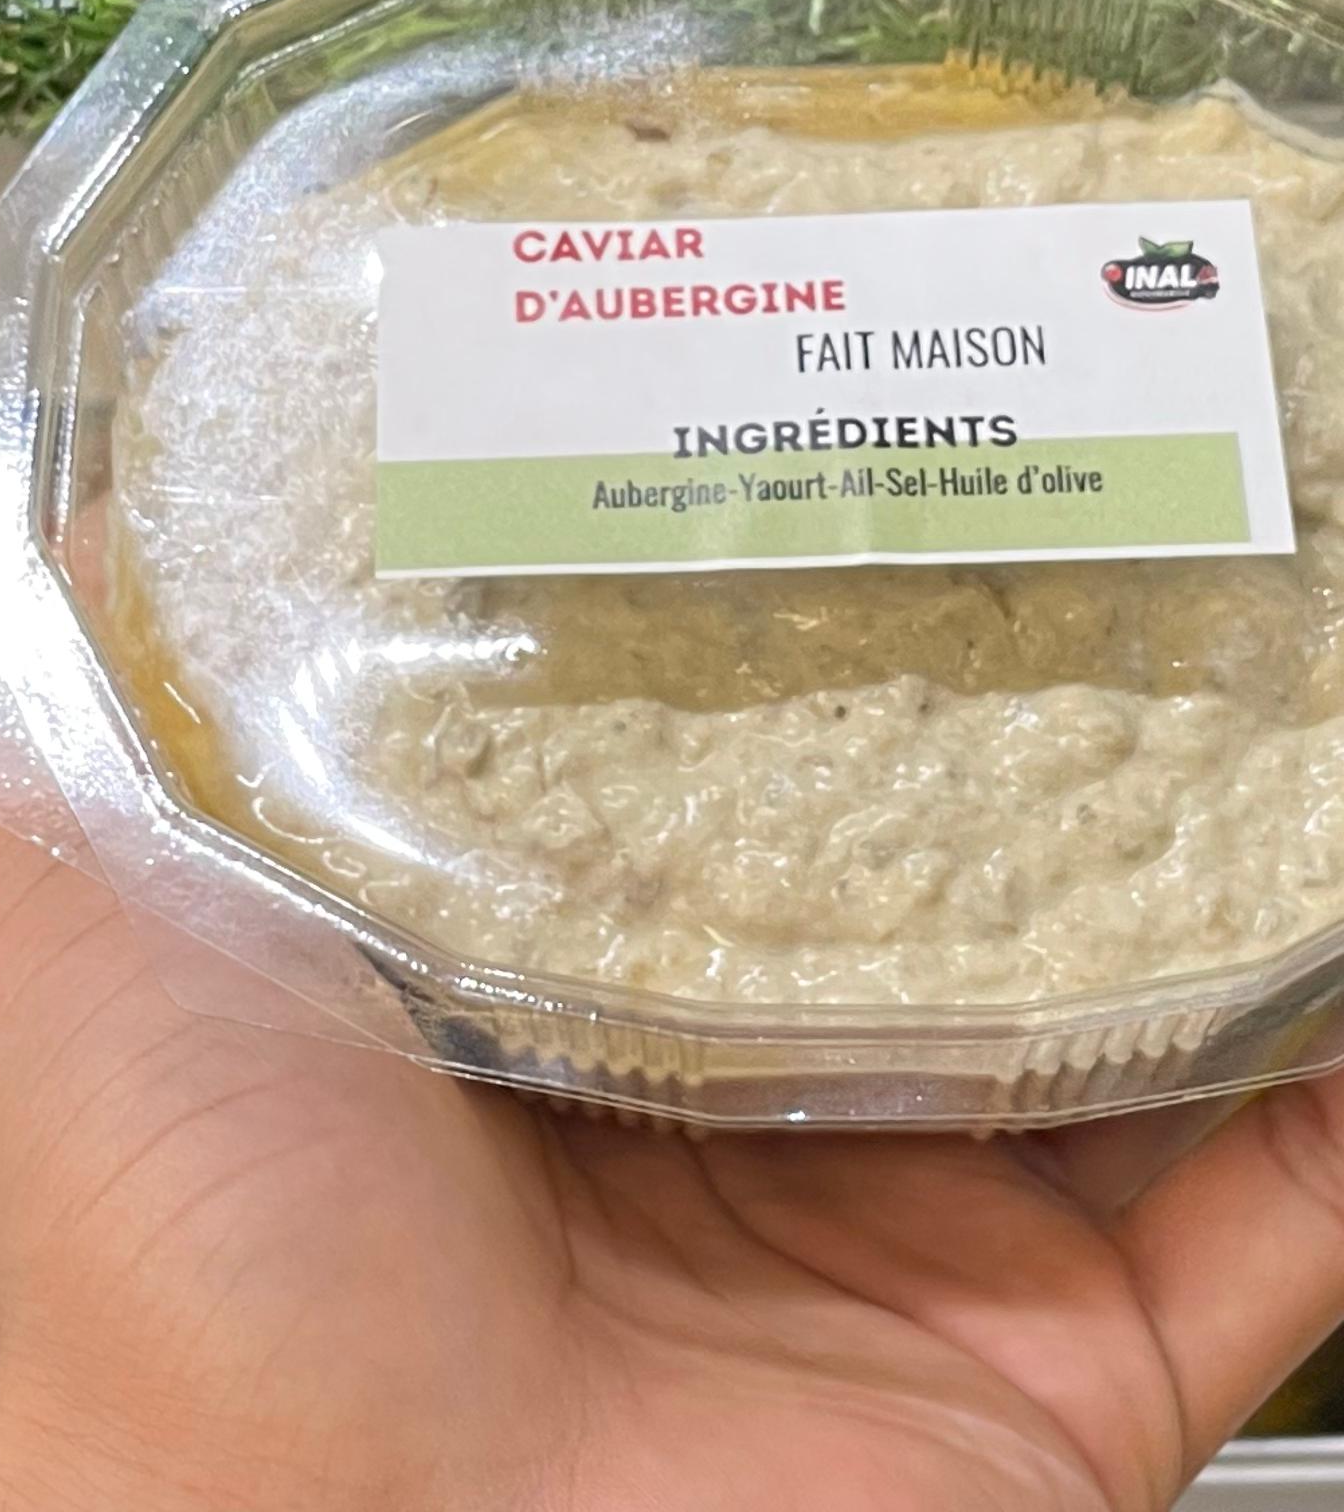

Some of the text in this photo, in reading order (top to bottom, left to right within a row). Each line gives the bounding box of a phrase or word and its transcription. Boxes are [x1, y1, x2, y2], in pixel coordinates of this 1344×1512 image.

[513, 228, 705, 263] CAVIAR
[1124, 263, 1198, 290] INAL
[515, 280, 846, 323] D'AUBERGINE
[796, 325, 1047, 373] FAIT MAISON
[673, 408, 1019, 459] INGRÉDIENTS
[592, 464, 1103, 513] Aubergine-Yaourt-Ail-Sel-Huile d'olive
